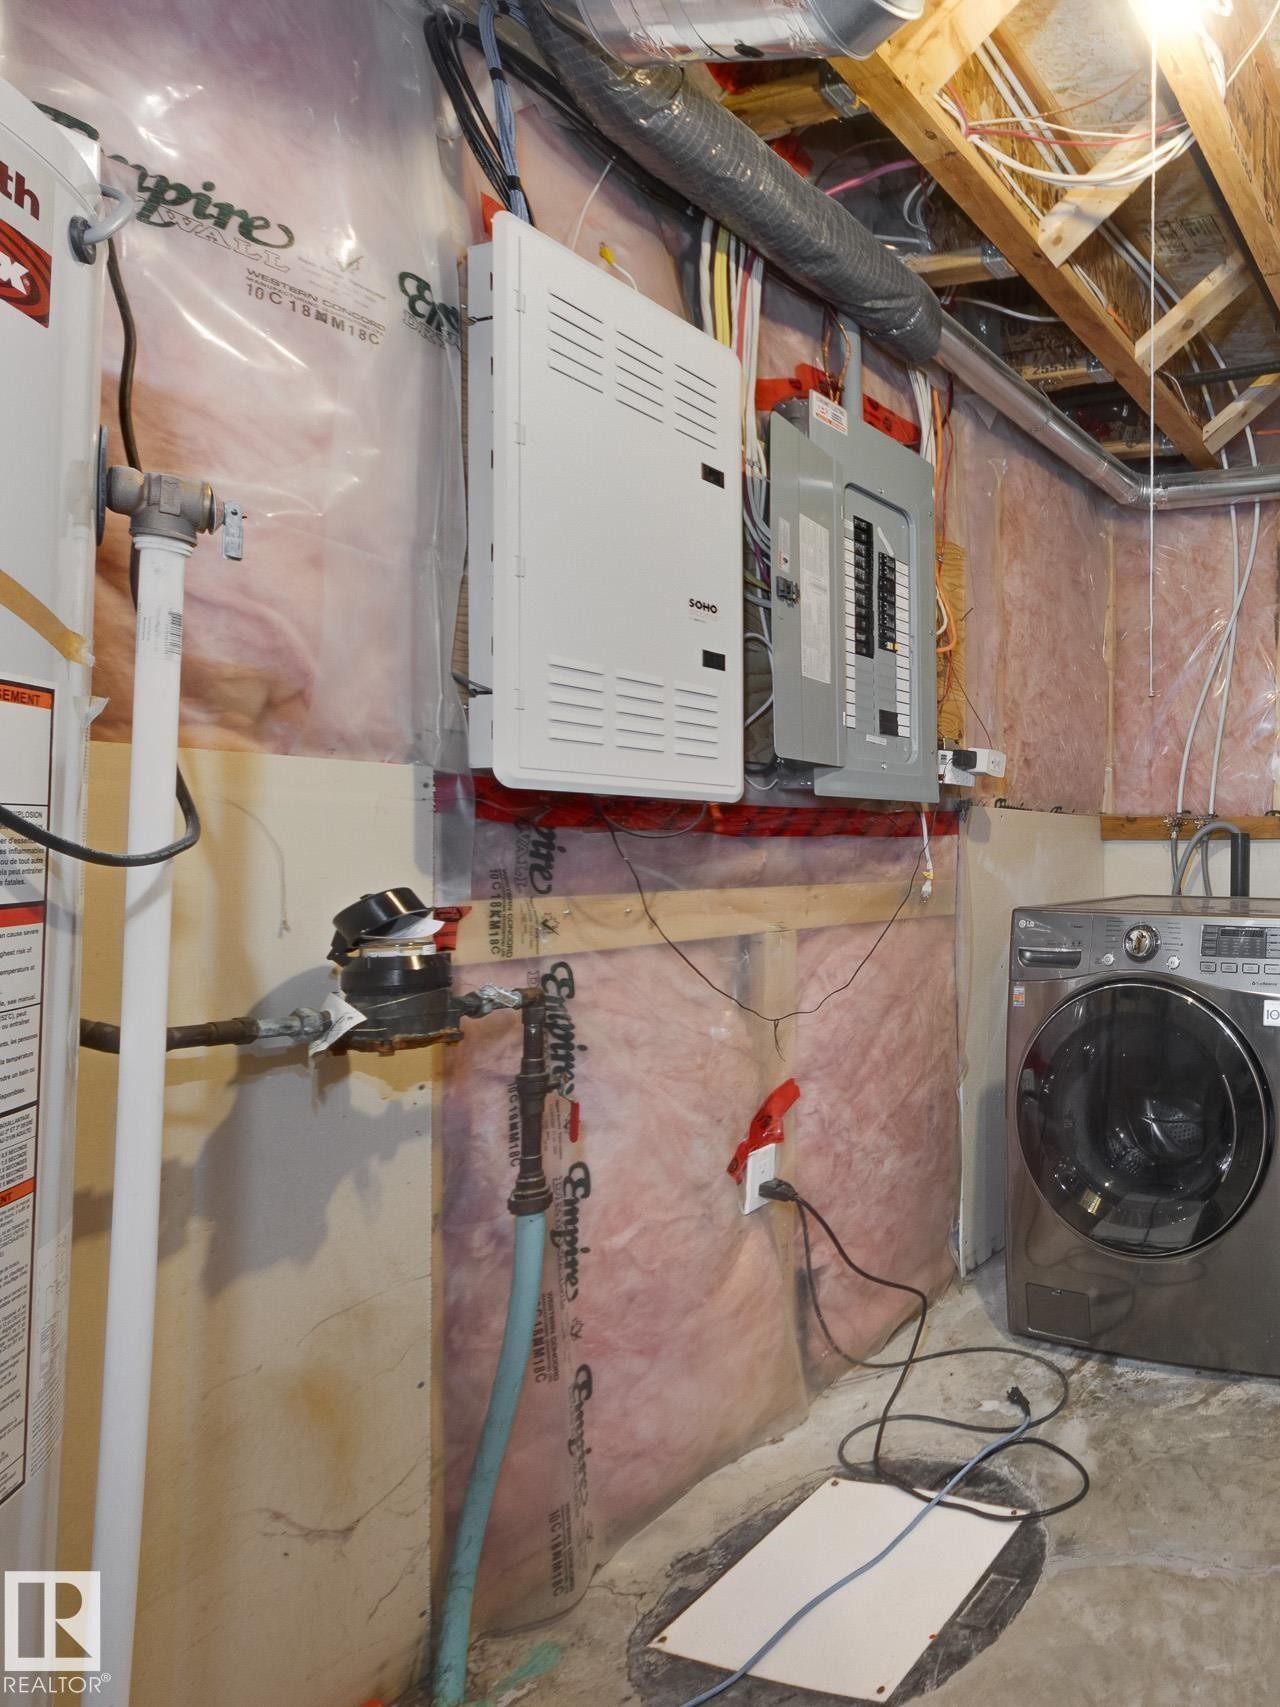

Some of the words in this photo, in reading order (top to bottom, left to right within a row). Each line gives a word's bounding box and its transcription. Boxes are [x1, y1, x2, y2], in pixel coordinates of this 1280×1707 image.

[322, 299, 387, 332] CONCORD
[689, 598, 718, 614] SOHO
[0, 688, 40, 706] EMENT
[550, 1161, 591, 1302] Empire
